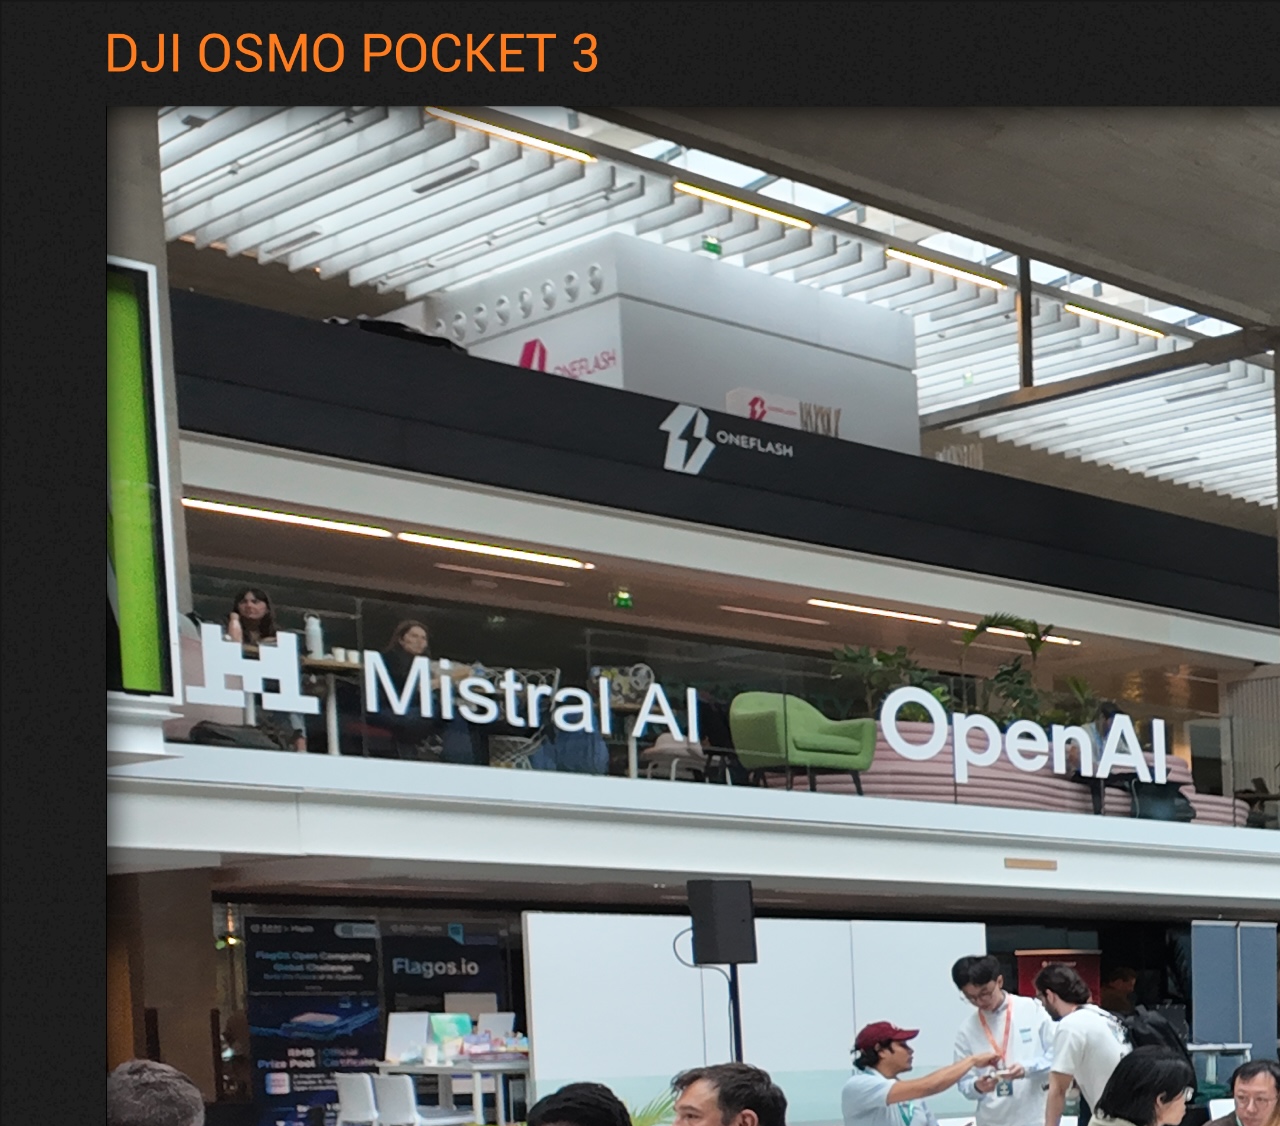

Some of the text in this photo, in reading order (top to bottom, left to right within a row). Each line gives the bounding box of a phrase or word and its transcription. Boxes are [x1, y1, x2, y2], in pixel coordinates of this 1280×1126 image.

[716, 430, 794, 458] ONEFLASH
[364, 649, 700, 743] Mistral AI
[880, 685, 1167, 784] OpenAI
